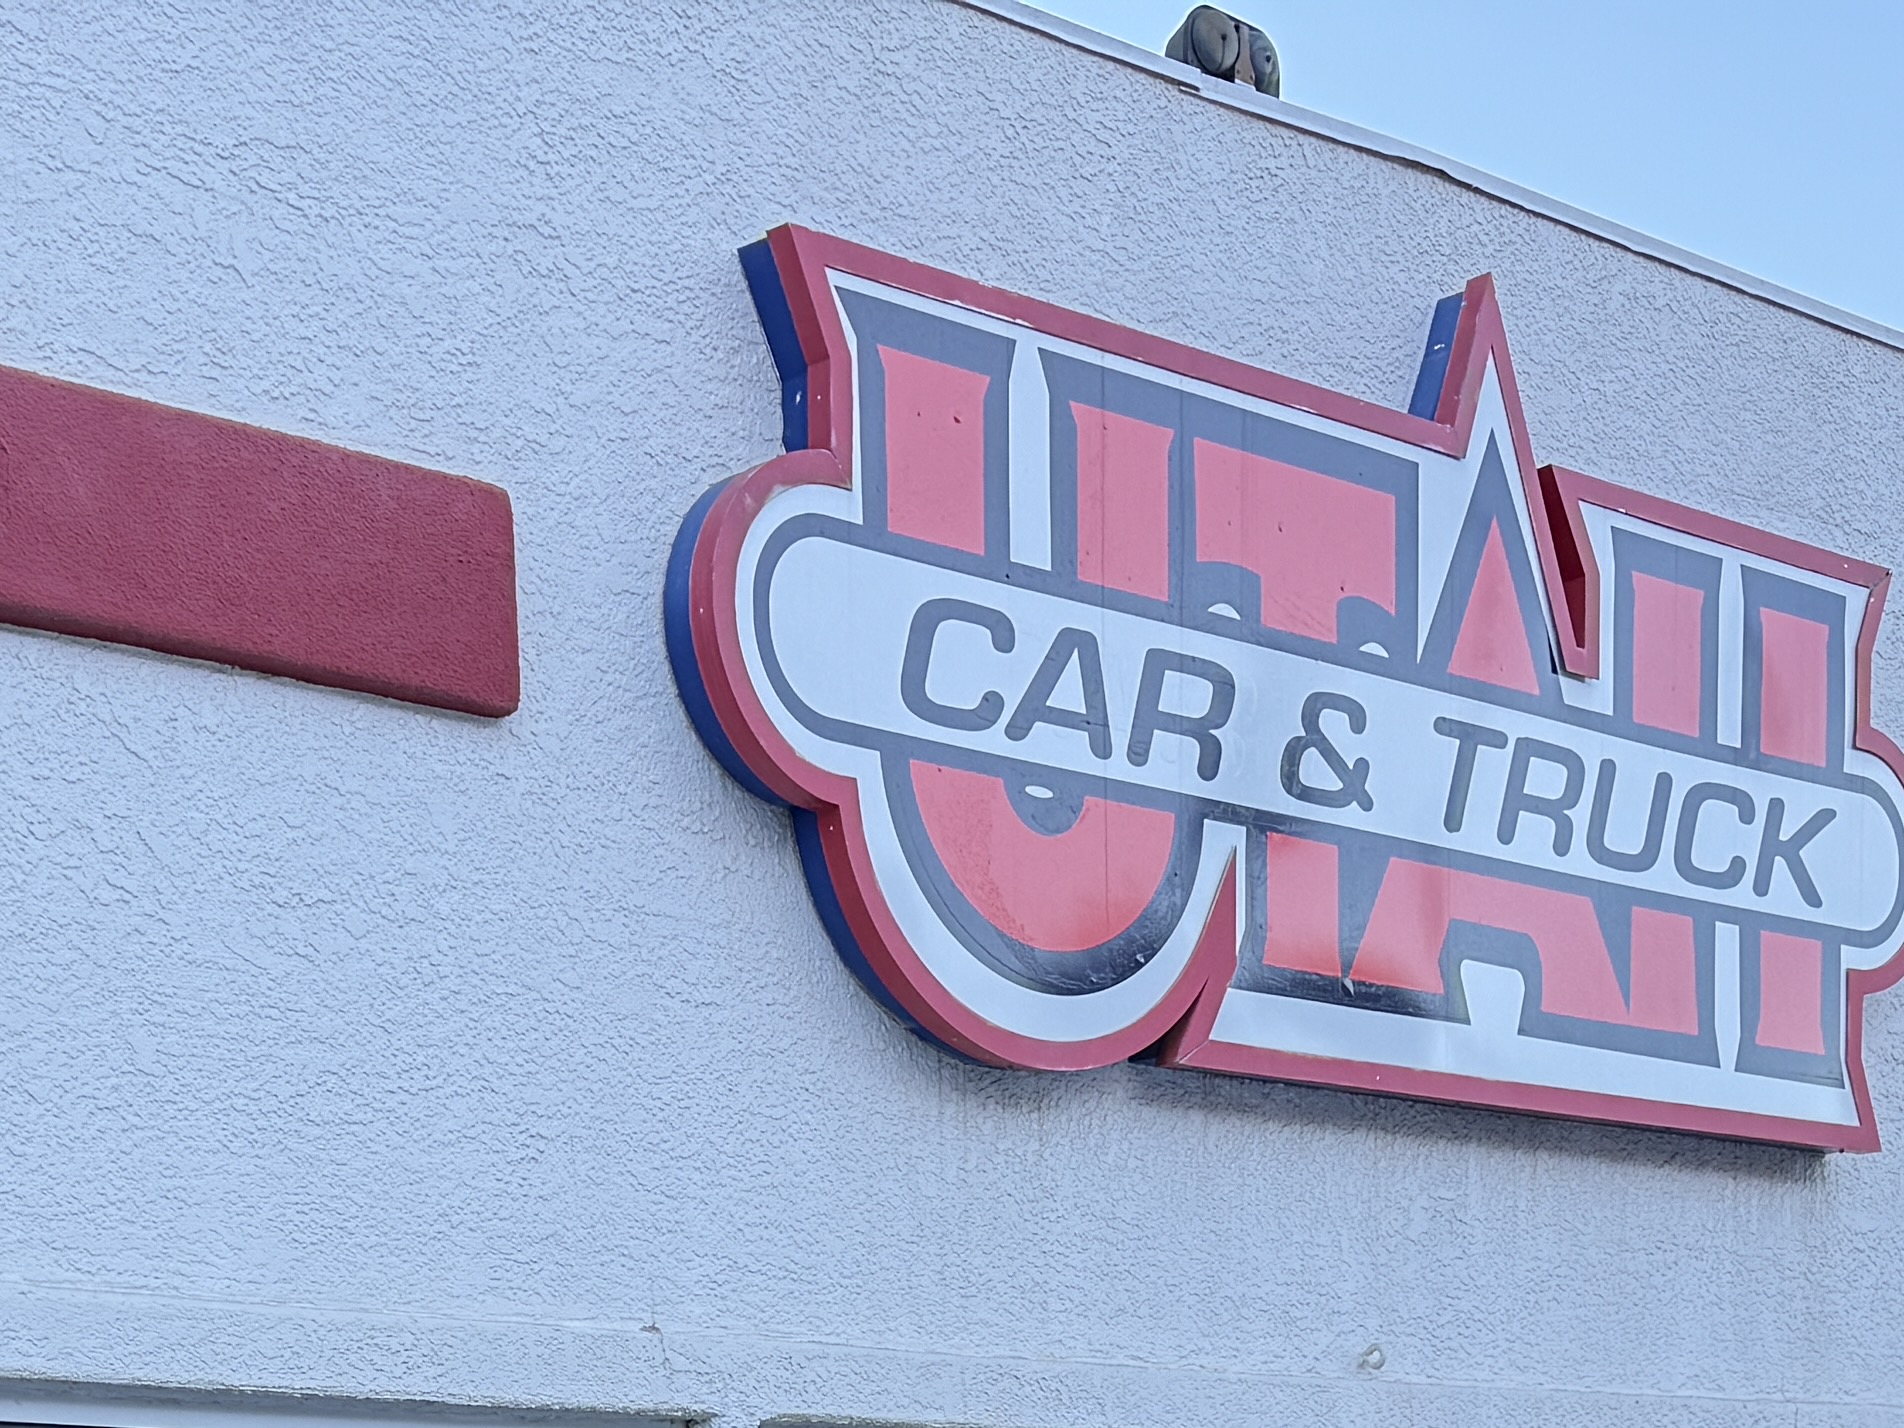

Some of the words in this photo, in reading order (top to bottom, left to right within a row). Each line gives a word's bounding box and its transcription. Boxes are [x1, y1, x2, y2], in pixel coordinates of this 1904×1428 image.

[900, 595, 1238, 782] CAR
[1277, 690, 1376, 813] &
[1434, 715, 1840, 910] TRUCK
